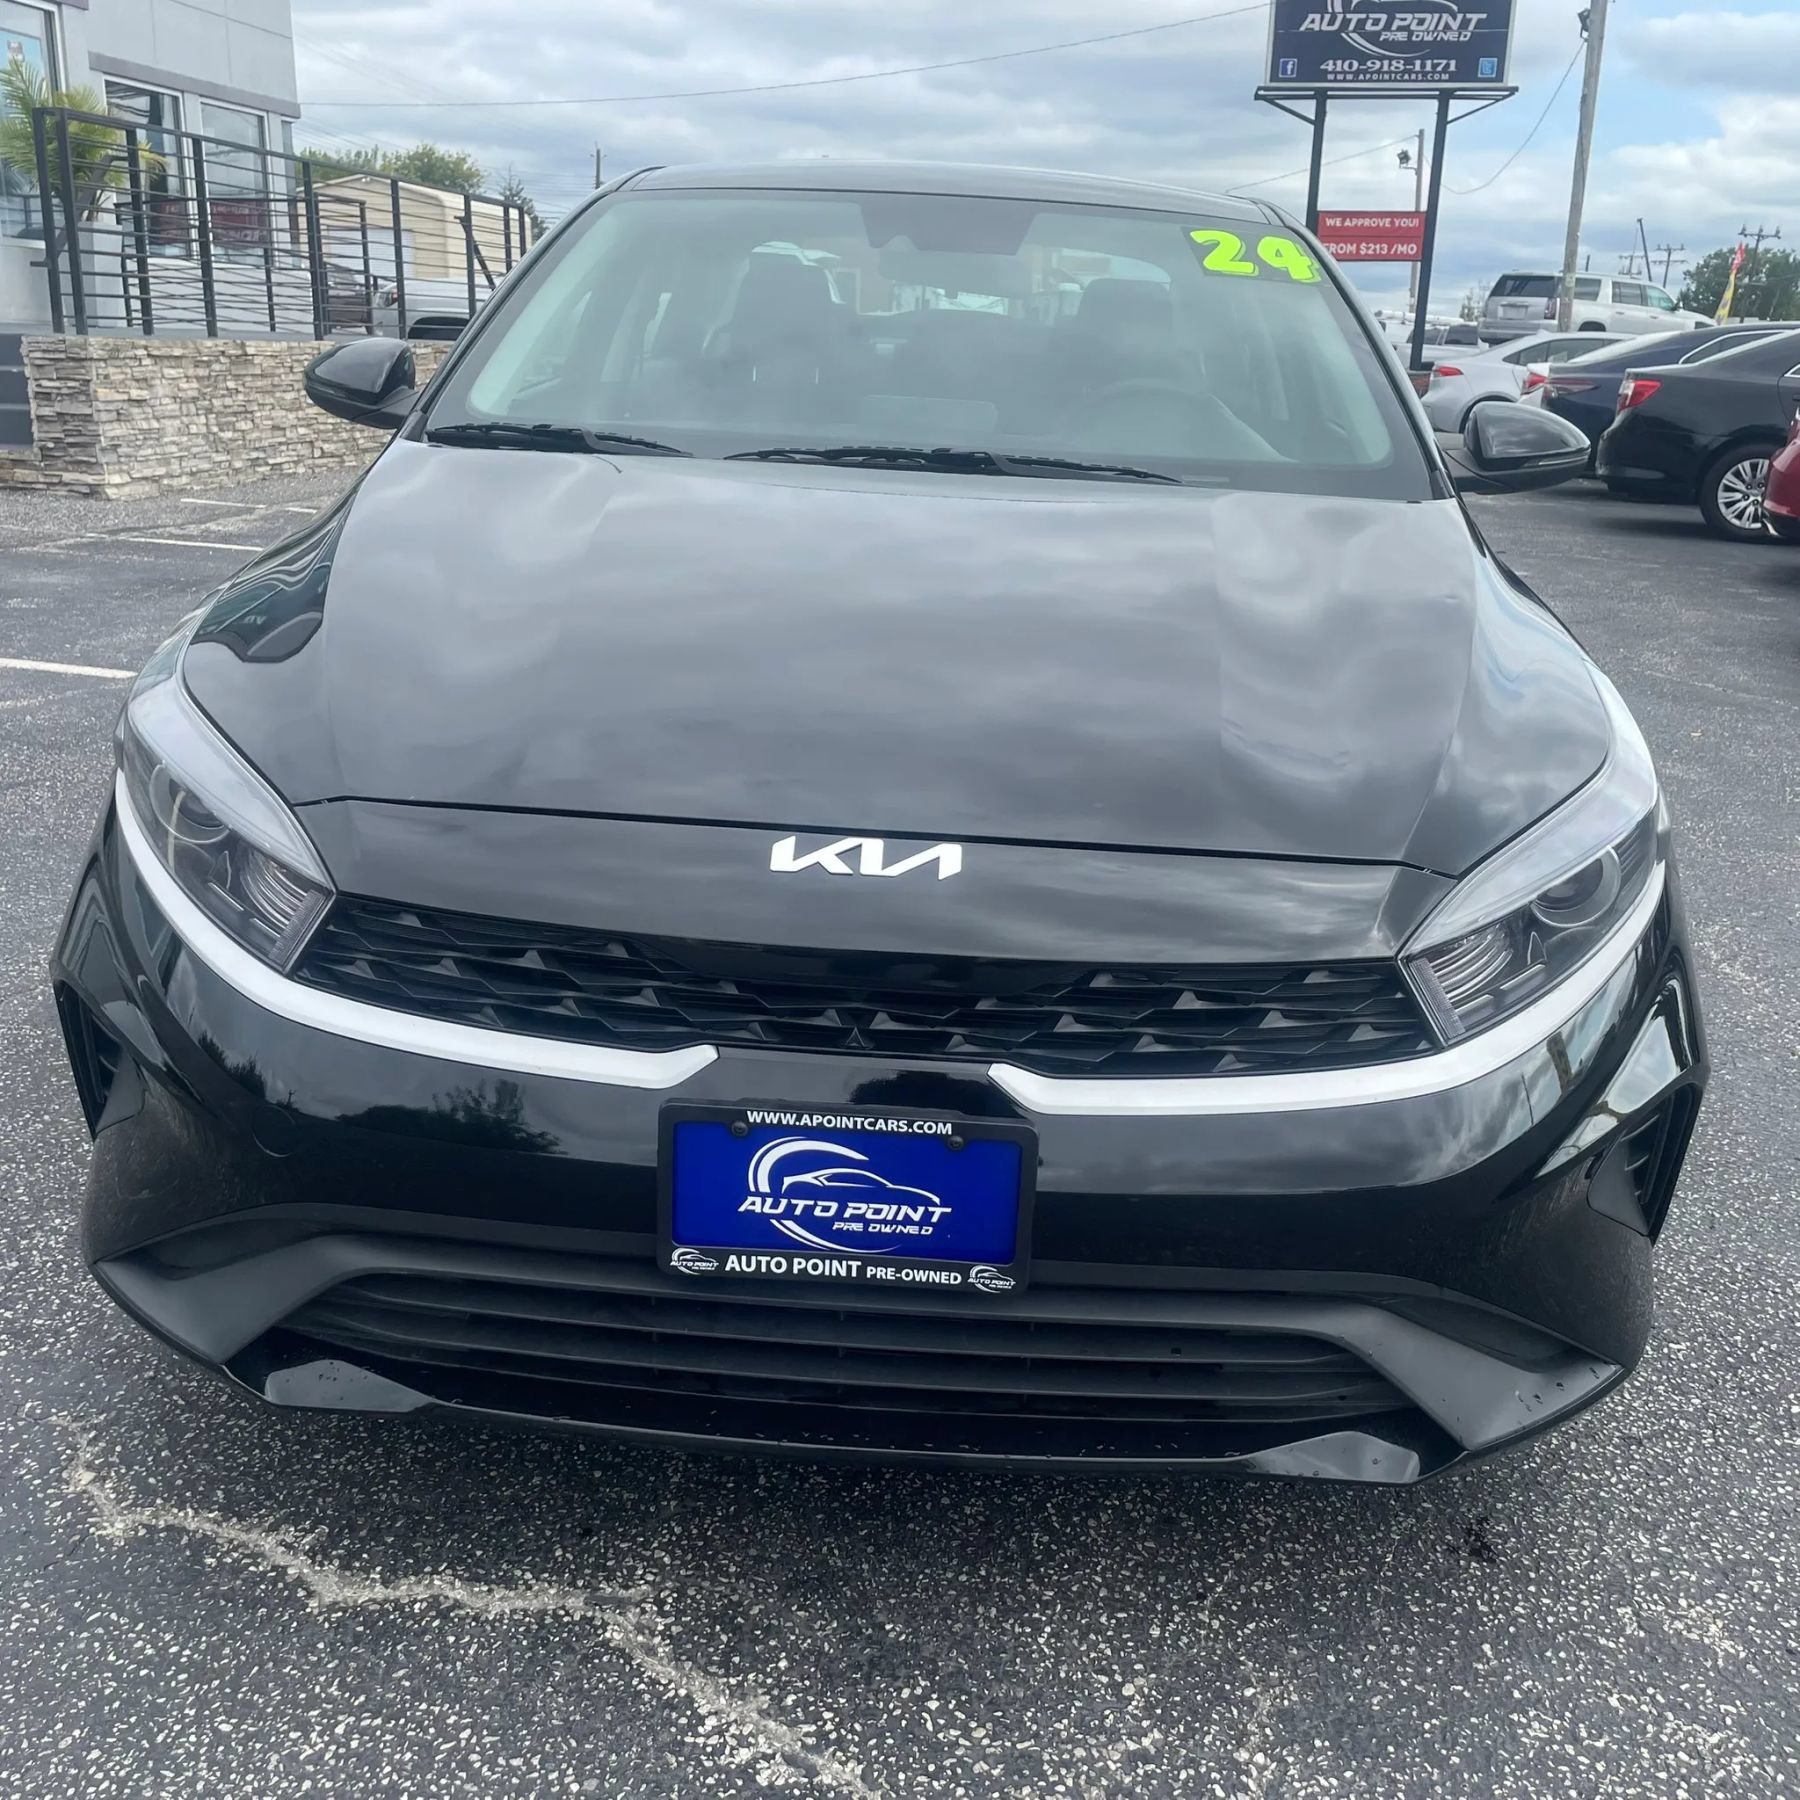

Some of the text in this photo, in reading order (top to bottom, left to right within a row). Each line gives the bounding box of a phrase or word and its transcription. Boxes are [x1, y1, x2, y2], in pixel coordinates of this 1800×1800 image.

[1299, 13, 1487, 31] AUTO POINT
[1379, 32, 1472, 41] PRE OWNED
[1319, 59, 1457, 72] 410-918-1171
[1325, 217, 1419, 227] WE APPROVE YOU!
[1190, 230, 1322, 283] 24
[1359, 242, 1388, 255] $213
[1391, 244, 1417, 254] /MO
[769, 835, 962, 880] KIA
[747, 1110, 952, 1135] WWW.APOINTCARS.COM
[738, 1196, 952, 1222] AUTO POINT
[832, 1222, 933, 1235] PRE OWNED
[725, 1255, 962, 1285] AUTO POINT PRE-OWNED
